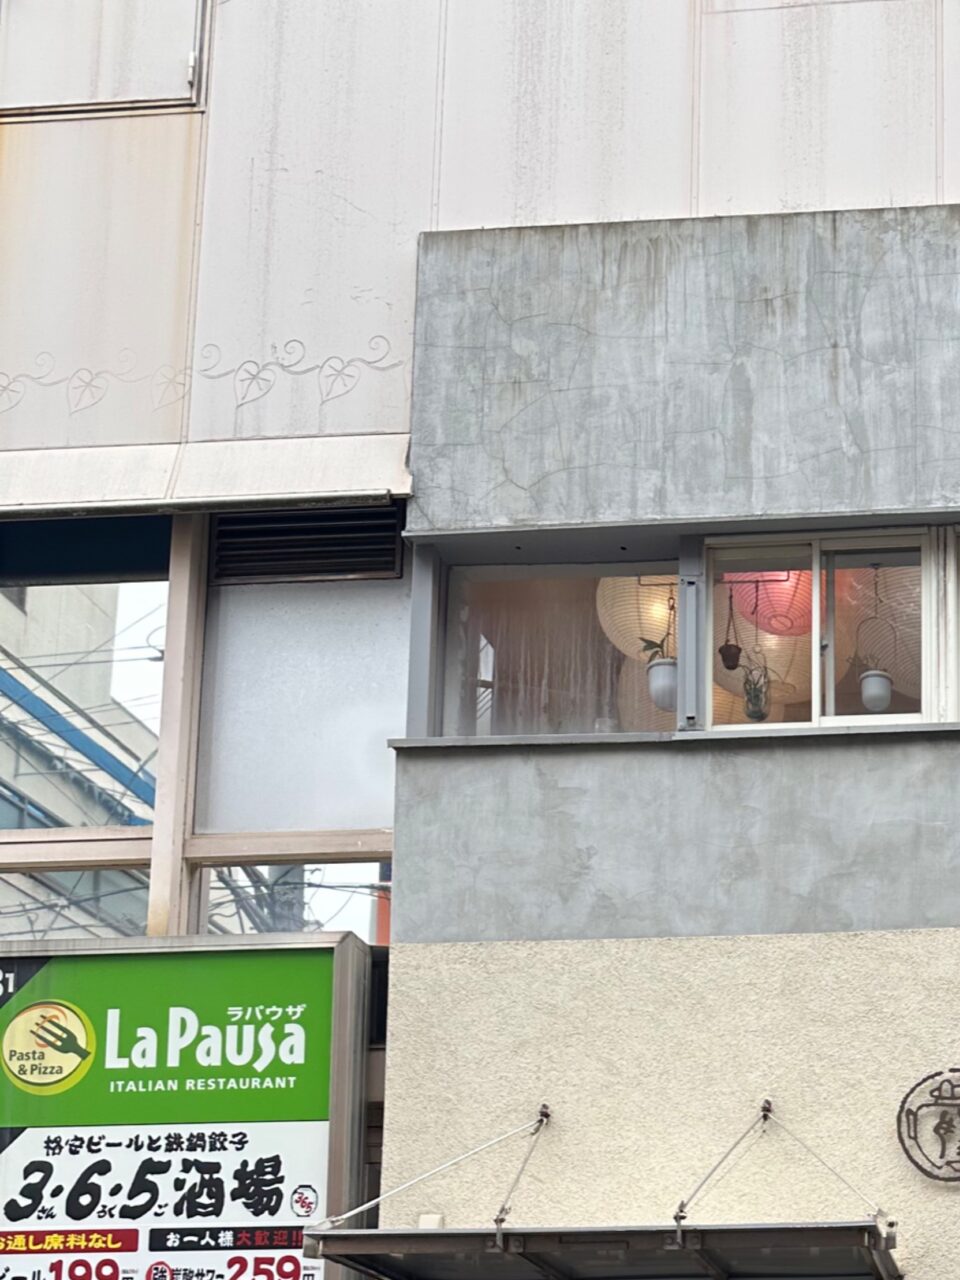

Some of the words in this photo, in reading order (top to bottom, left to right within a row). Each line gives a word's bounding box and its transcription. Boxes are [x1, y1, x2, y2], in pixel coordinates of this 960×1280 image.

[104, 1008, 157, 1069] La
[166, 1006, 306, 1073] Pausa
[8, 1049, 45, 1062] Pasta
[18, 1065, 28, 1076] &
[30, 1063, 63, 1076] Pizza
[110, 1079, 178, 1092] ITALIAN
[185, 1076, 297, 1091] RESTAURANT
